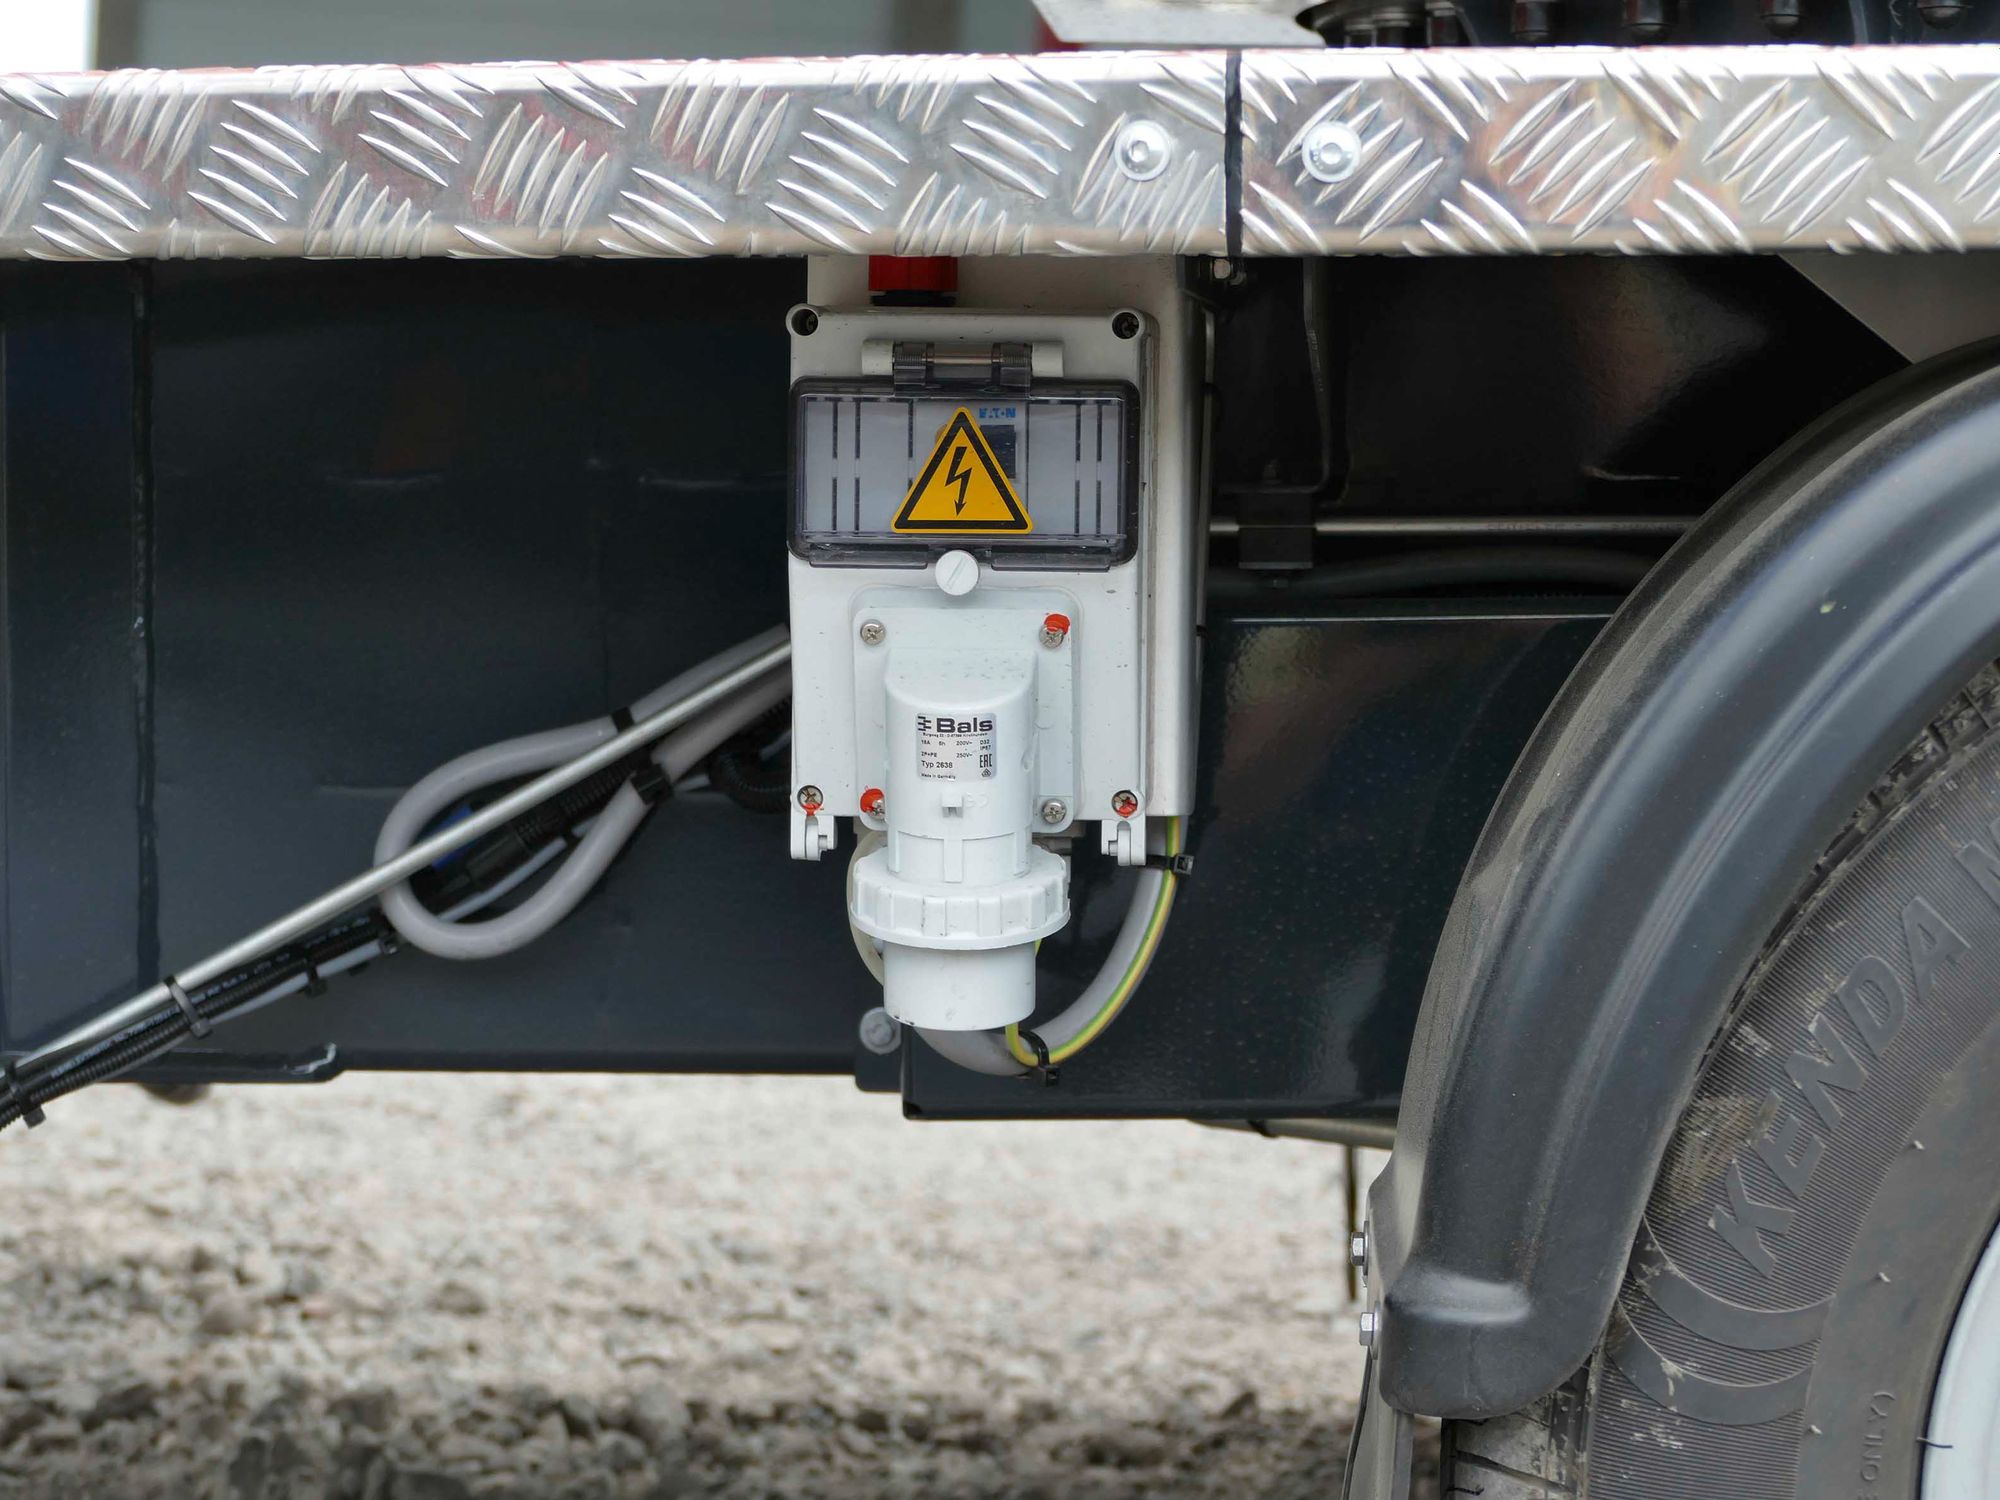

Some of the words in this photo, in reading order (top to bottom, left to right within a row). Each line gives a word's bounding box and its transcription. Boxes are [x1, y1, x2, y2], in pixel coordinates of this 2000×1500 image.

[937, 717, 993, 733] Bals
[921, 759, 935, 769] Typ
[936, 761, 953, 769] 2638
[1708, 896, 1972, 1279] KENDA
